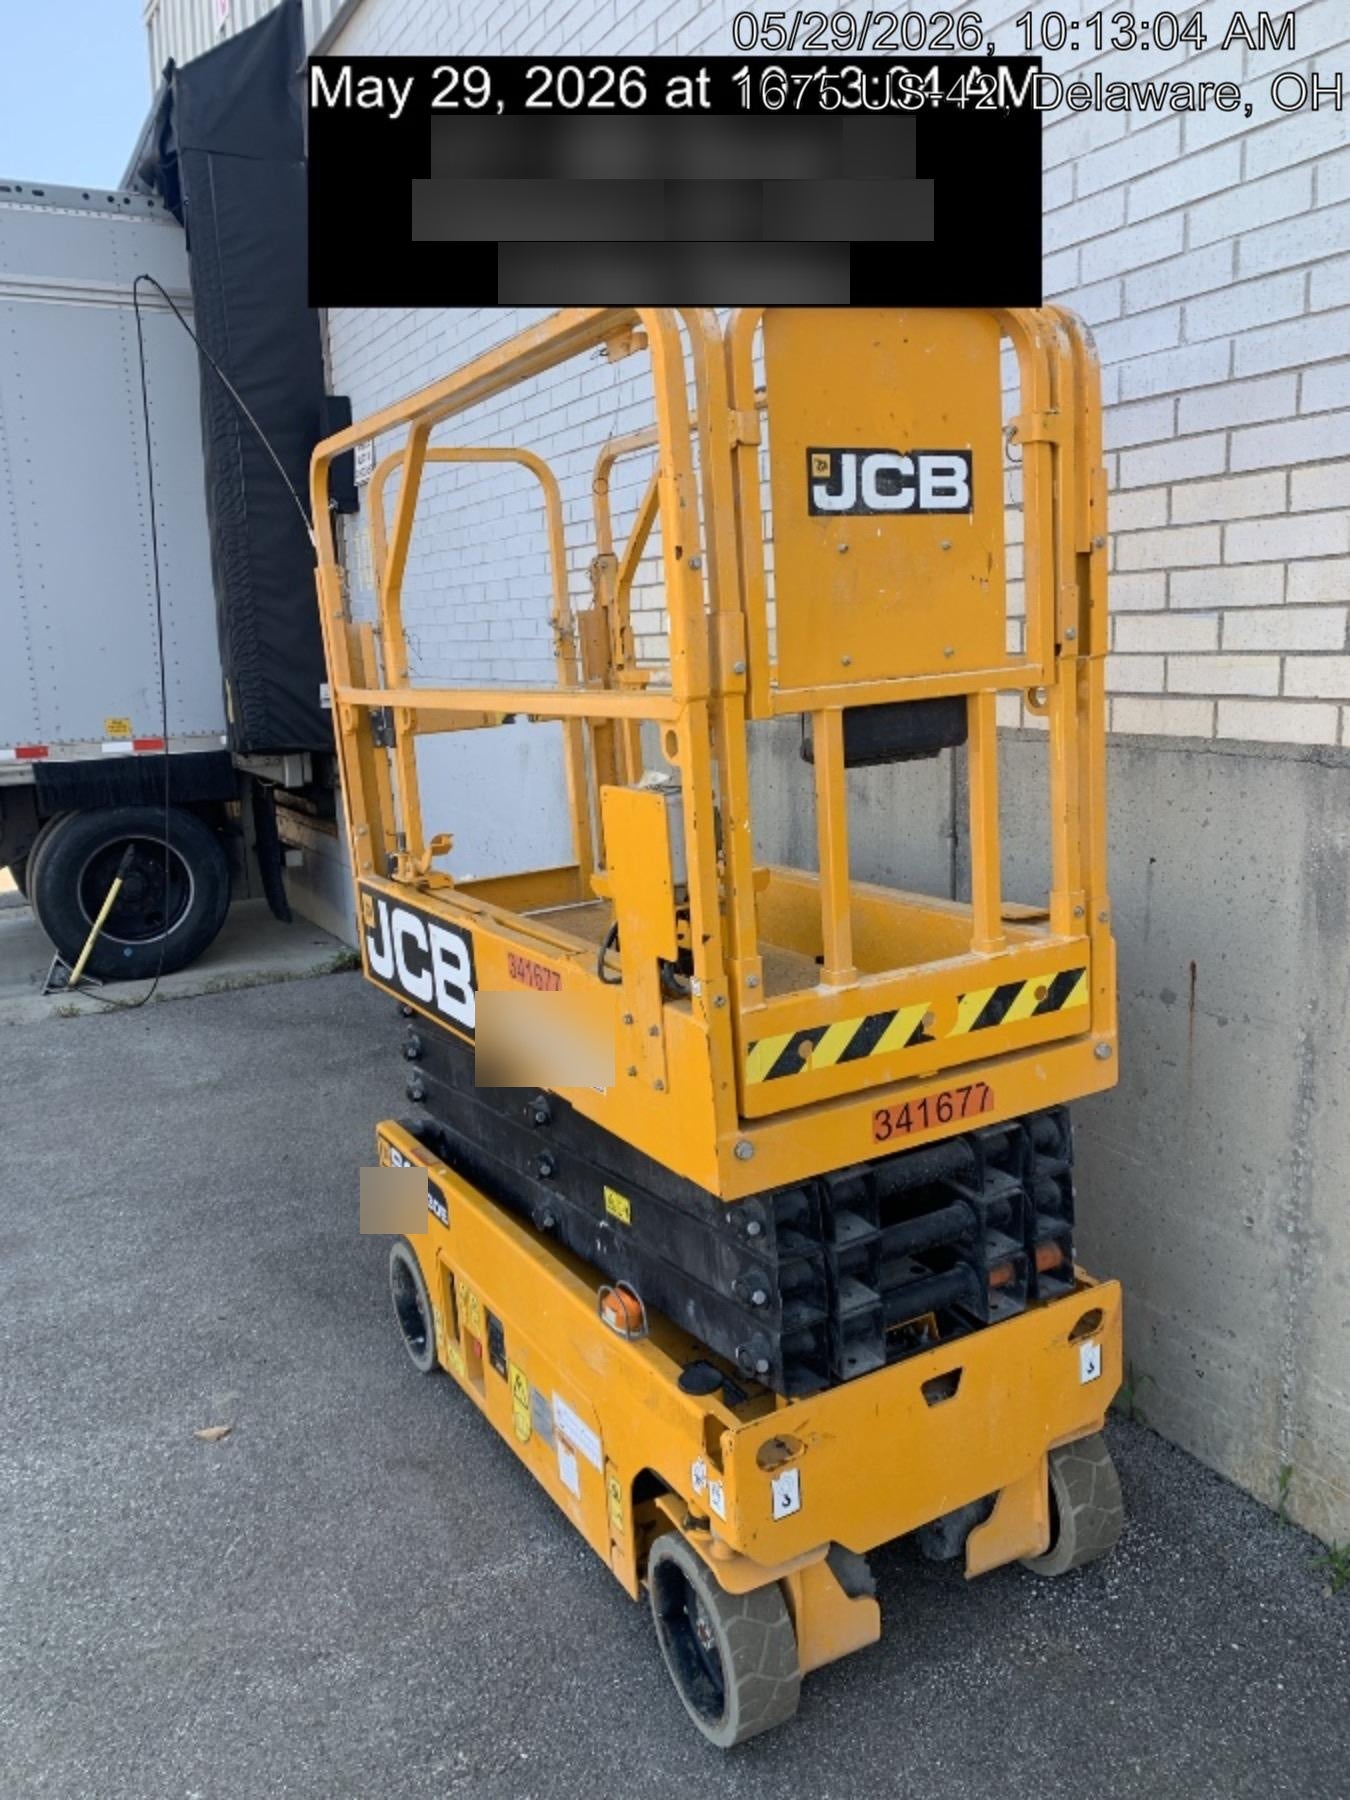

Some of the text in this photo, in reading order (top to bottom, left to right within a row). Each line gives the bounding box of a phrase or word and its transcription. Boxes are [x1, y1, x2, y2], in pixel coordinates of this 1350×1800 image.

[812, 453, 970, 511] JCB
[366, 899, 475, 1029] JCB
[875, 1081, 989, 1141] 341677
